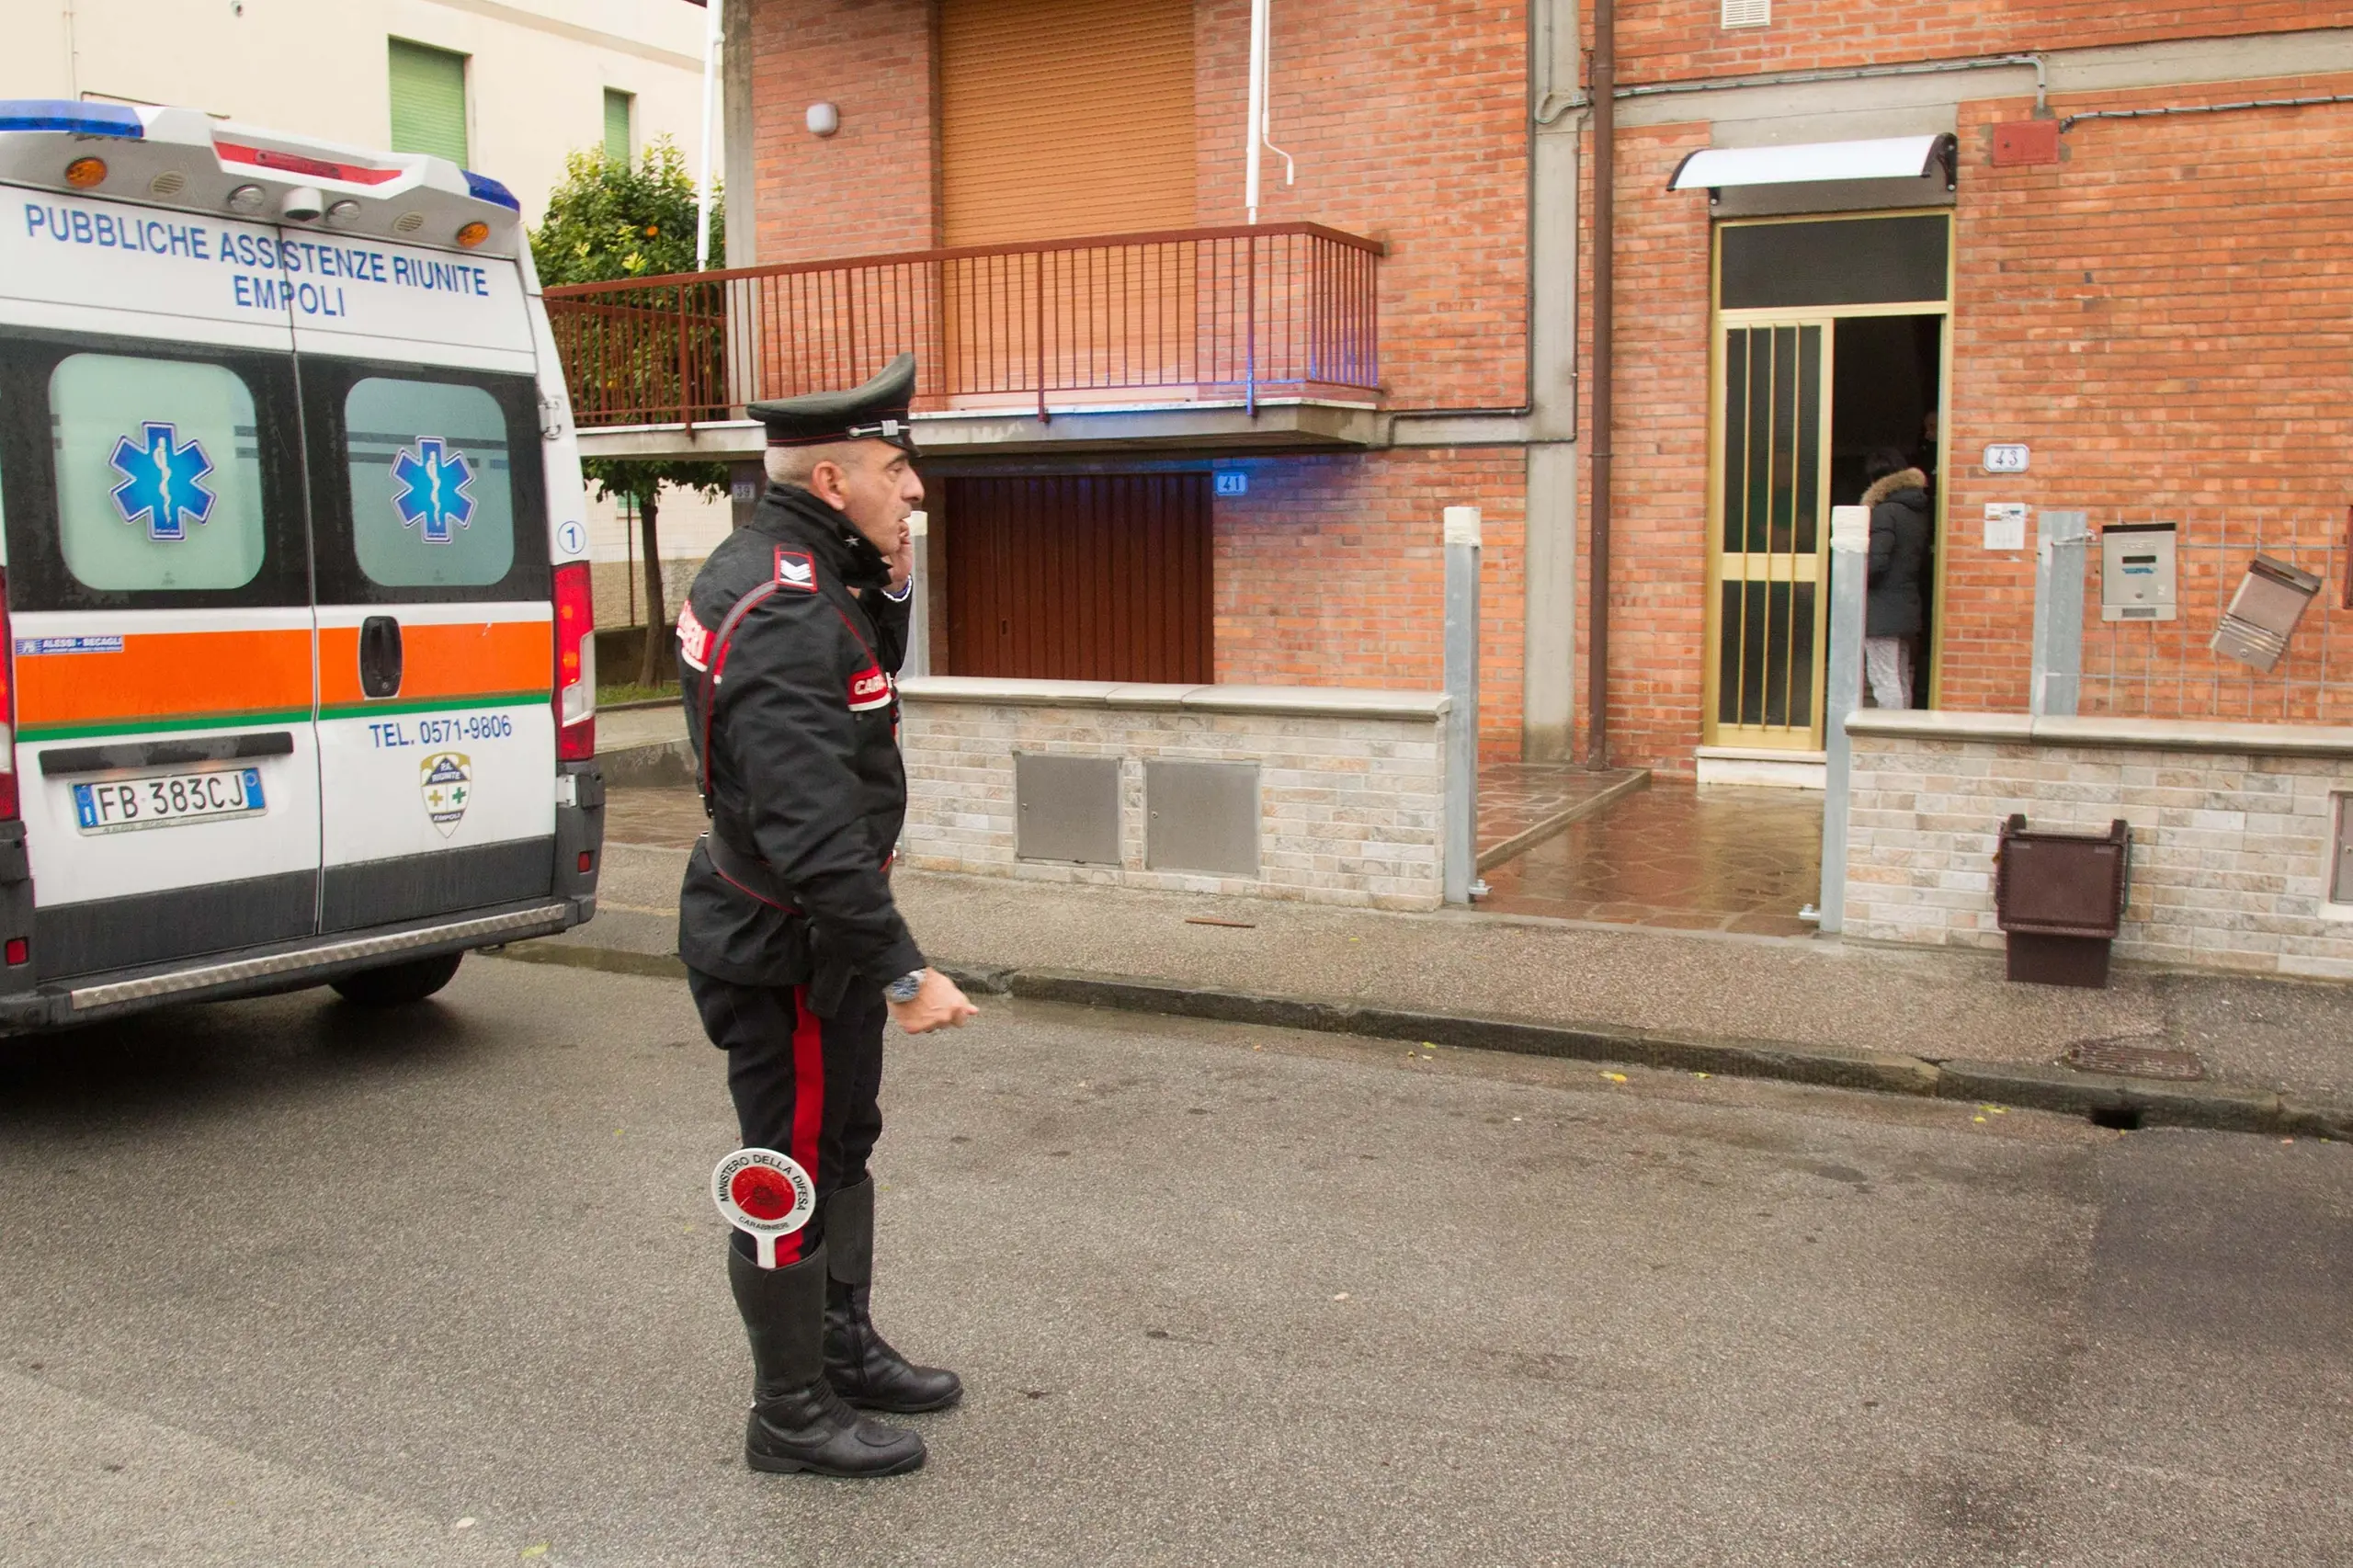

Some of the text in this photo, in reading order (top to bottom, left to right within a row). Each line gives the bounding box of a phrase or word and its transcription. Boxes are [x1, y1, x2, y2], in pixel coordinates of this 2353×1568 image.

[25, 203, 489, 296] PUBBLICHE ASSISTENZE RIUNITE
[233, 275, 346, 317] EMPOLI
[1995, 449, 2018, 466] 43
[736, 485, 751, 497] 39
[1223, 476, 1240, 491] 41
[565, 526, 575, 549] 1
[369, 715, 513, 748] TEL. 0571-9806
[432, 771, 461, 782] RIUNITE
[97, 774, 244, 821] FB 383CJ
[434, 812, 462, 822] EMPOLI
[718, 1154, 809, 1211] MINISTERO DELLA DIFESA
[738, 1215, 790, 1231] CARABINIERI
